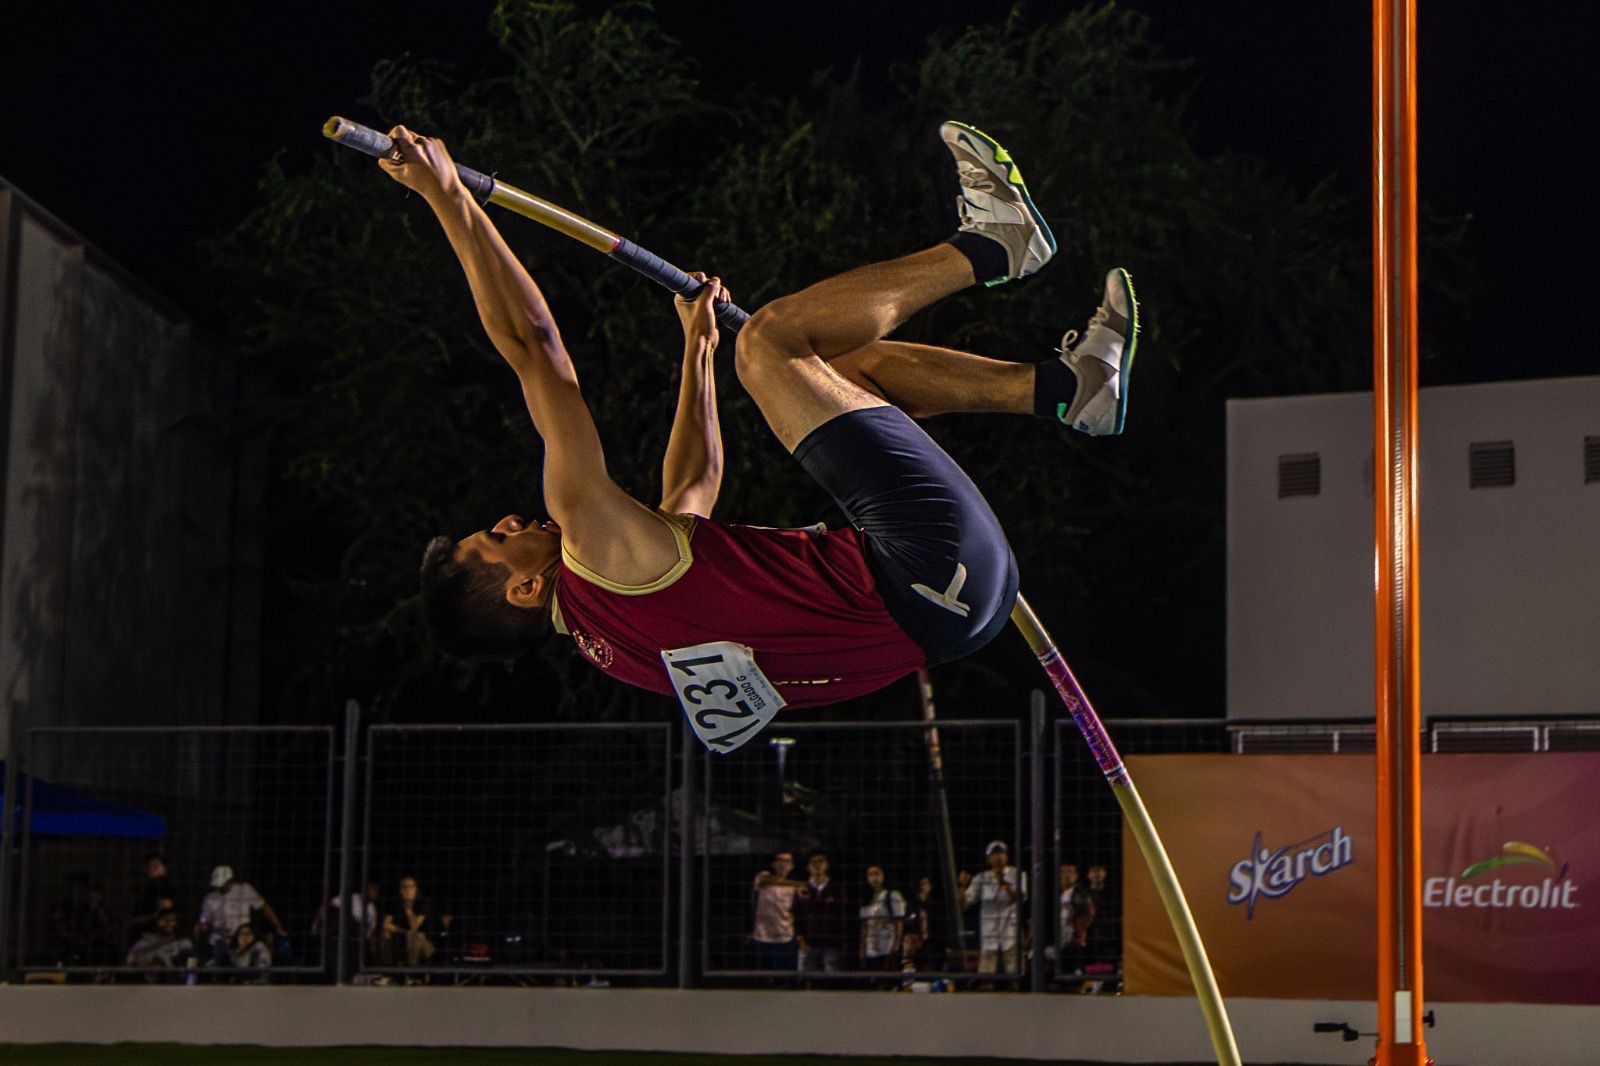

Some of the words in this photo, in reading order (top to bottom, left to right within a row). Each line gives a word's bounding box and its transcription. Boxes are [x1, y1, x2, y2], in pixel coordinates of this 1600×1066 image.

[671, 654, 760, 747] 1231
[740, 682, 767, 711] DELGADO
[1423, 875, 1579, 909] Electrolit
